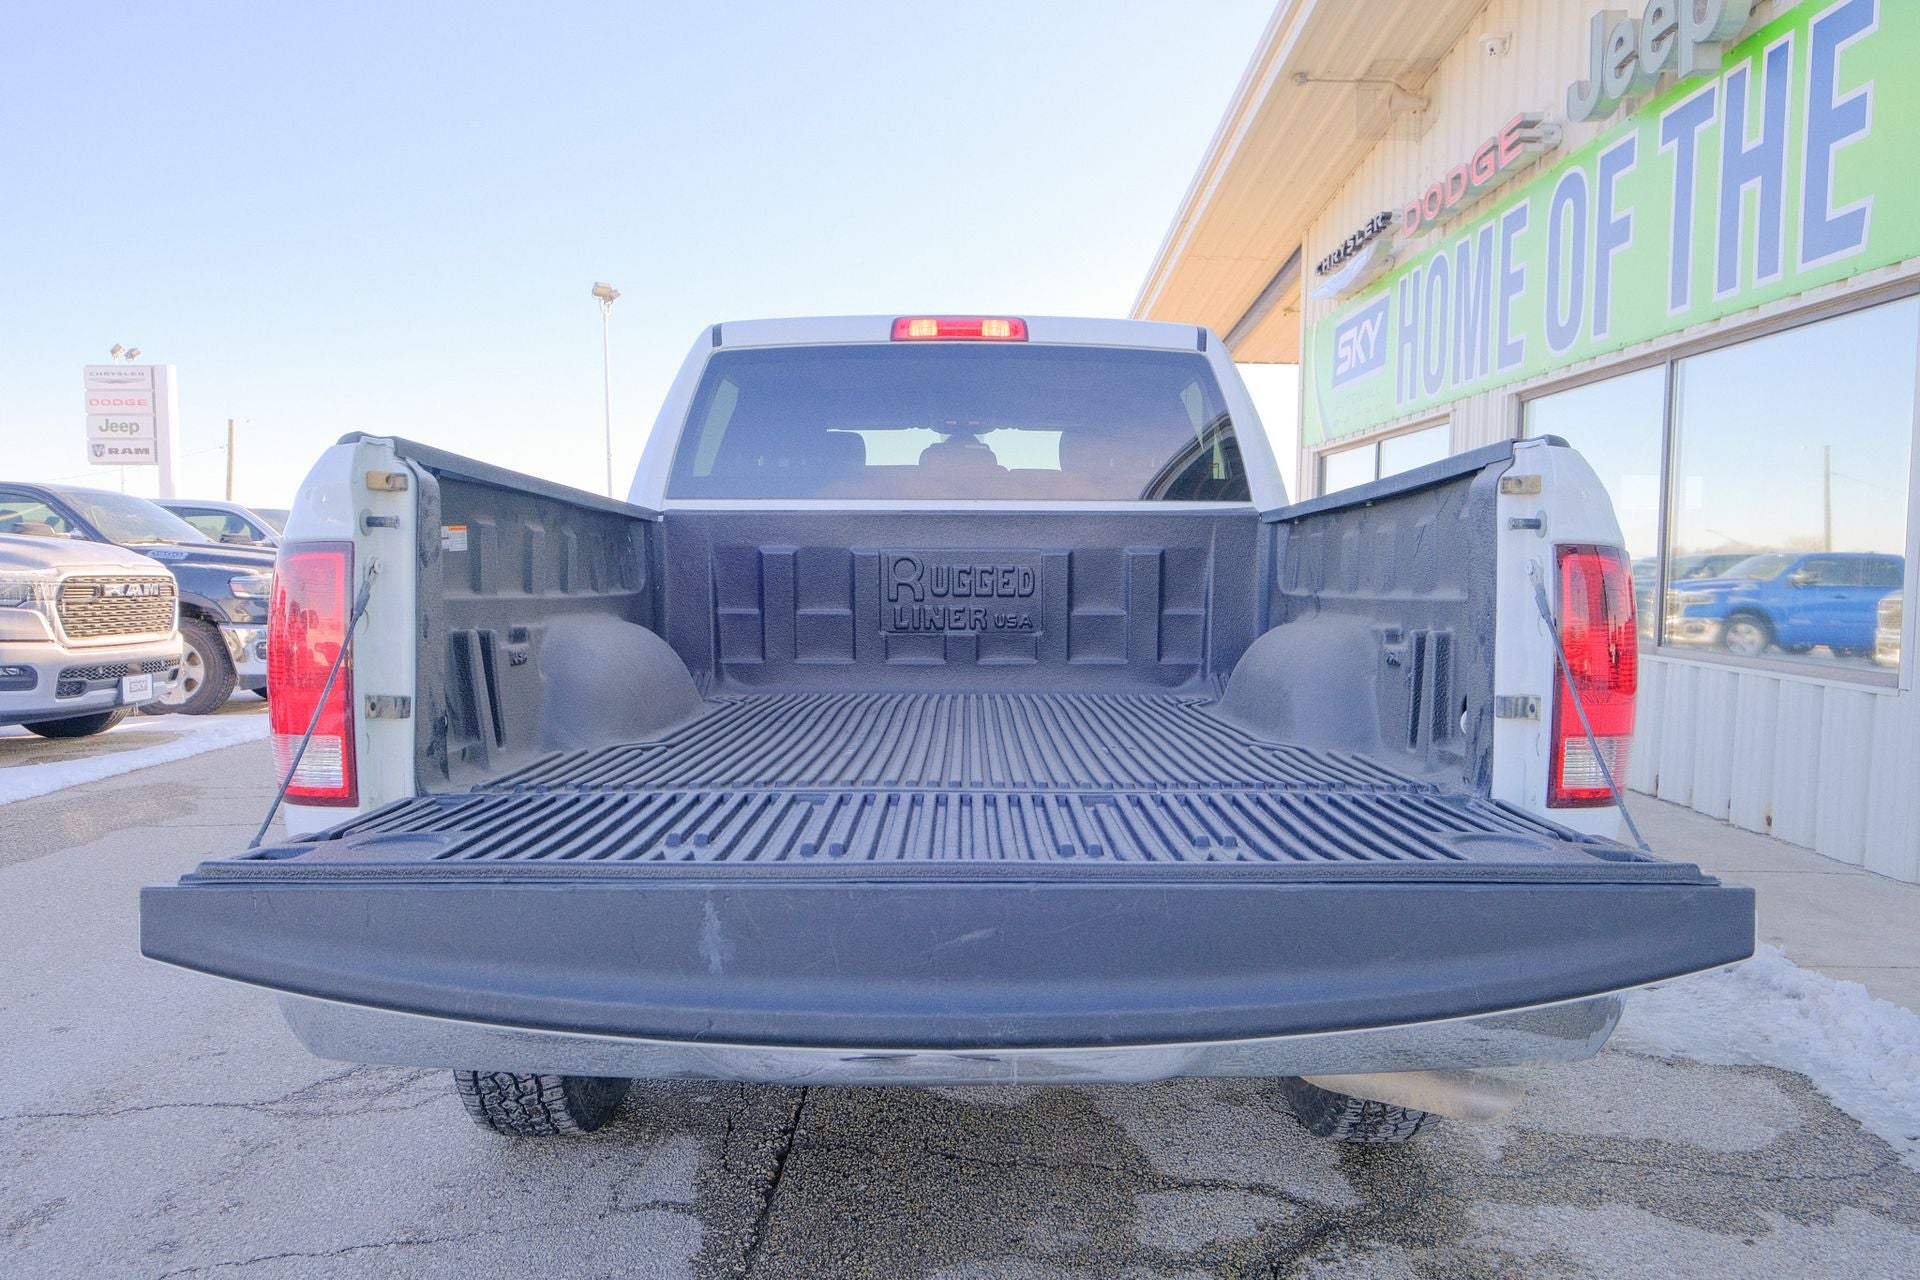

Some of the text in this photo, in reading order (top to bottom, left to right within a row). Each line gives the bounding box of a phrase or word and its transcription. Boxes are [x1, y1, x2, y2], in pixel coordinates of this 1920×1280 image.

[1567, 0, 1730, 122] Jeep
[1395, 0, 1879, 406] HOME OF THE
[1402, 112, 1529, 238] DODGE
[1315, 211, 1393, 276] CHRYSLER
[1335, 310, 1384, 376] SKY
[98, 418, 140, 435] Jeep
[108, 447, 150, 455] RAM
[104, 584, 160, 597] RAM
[887, 554, 1036, 602] RUGGED
[893, 605, 1034, 630] LINER USA
